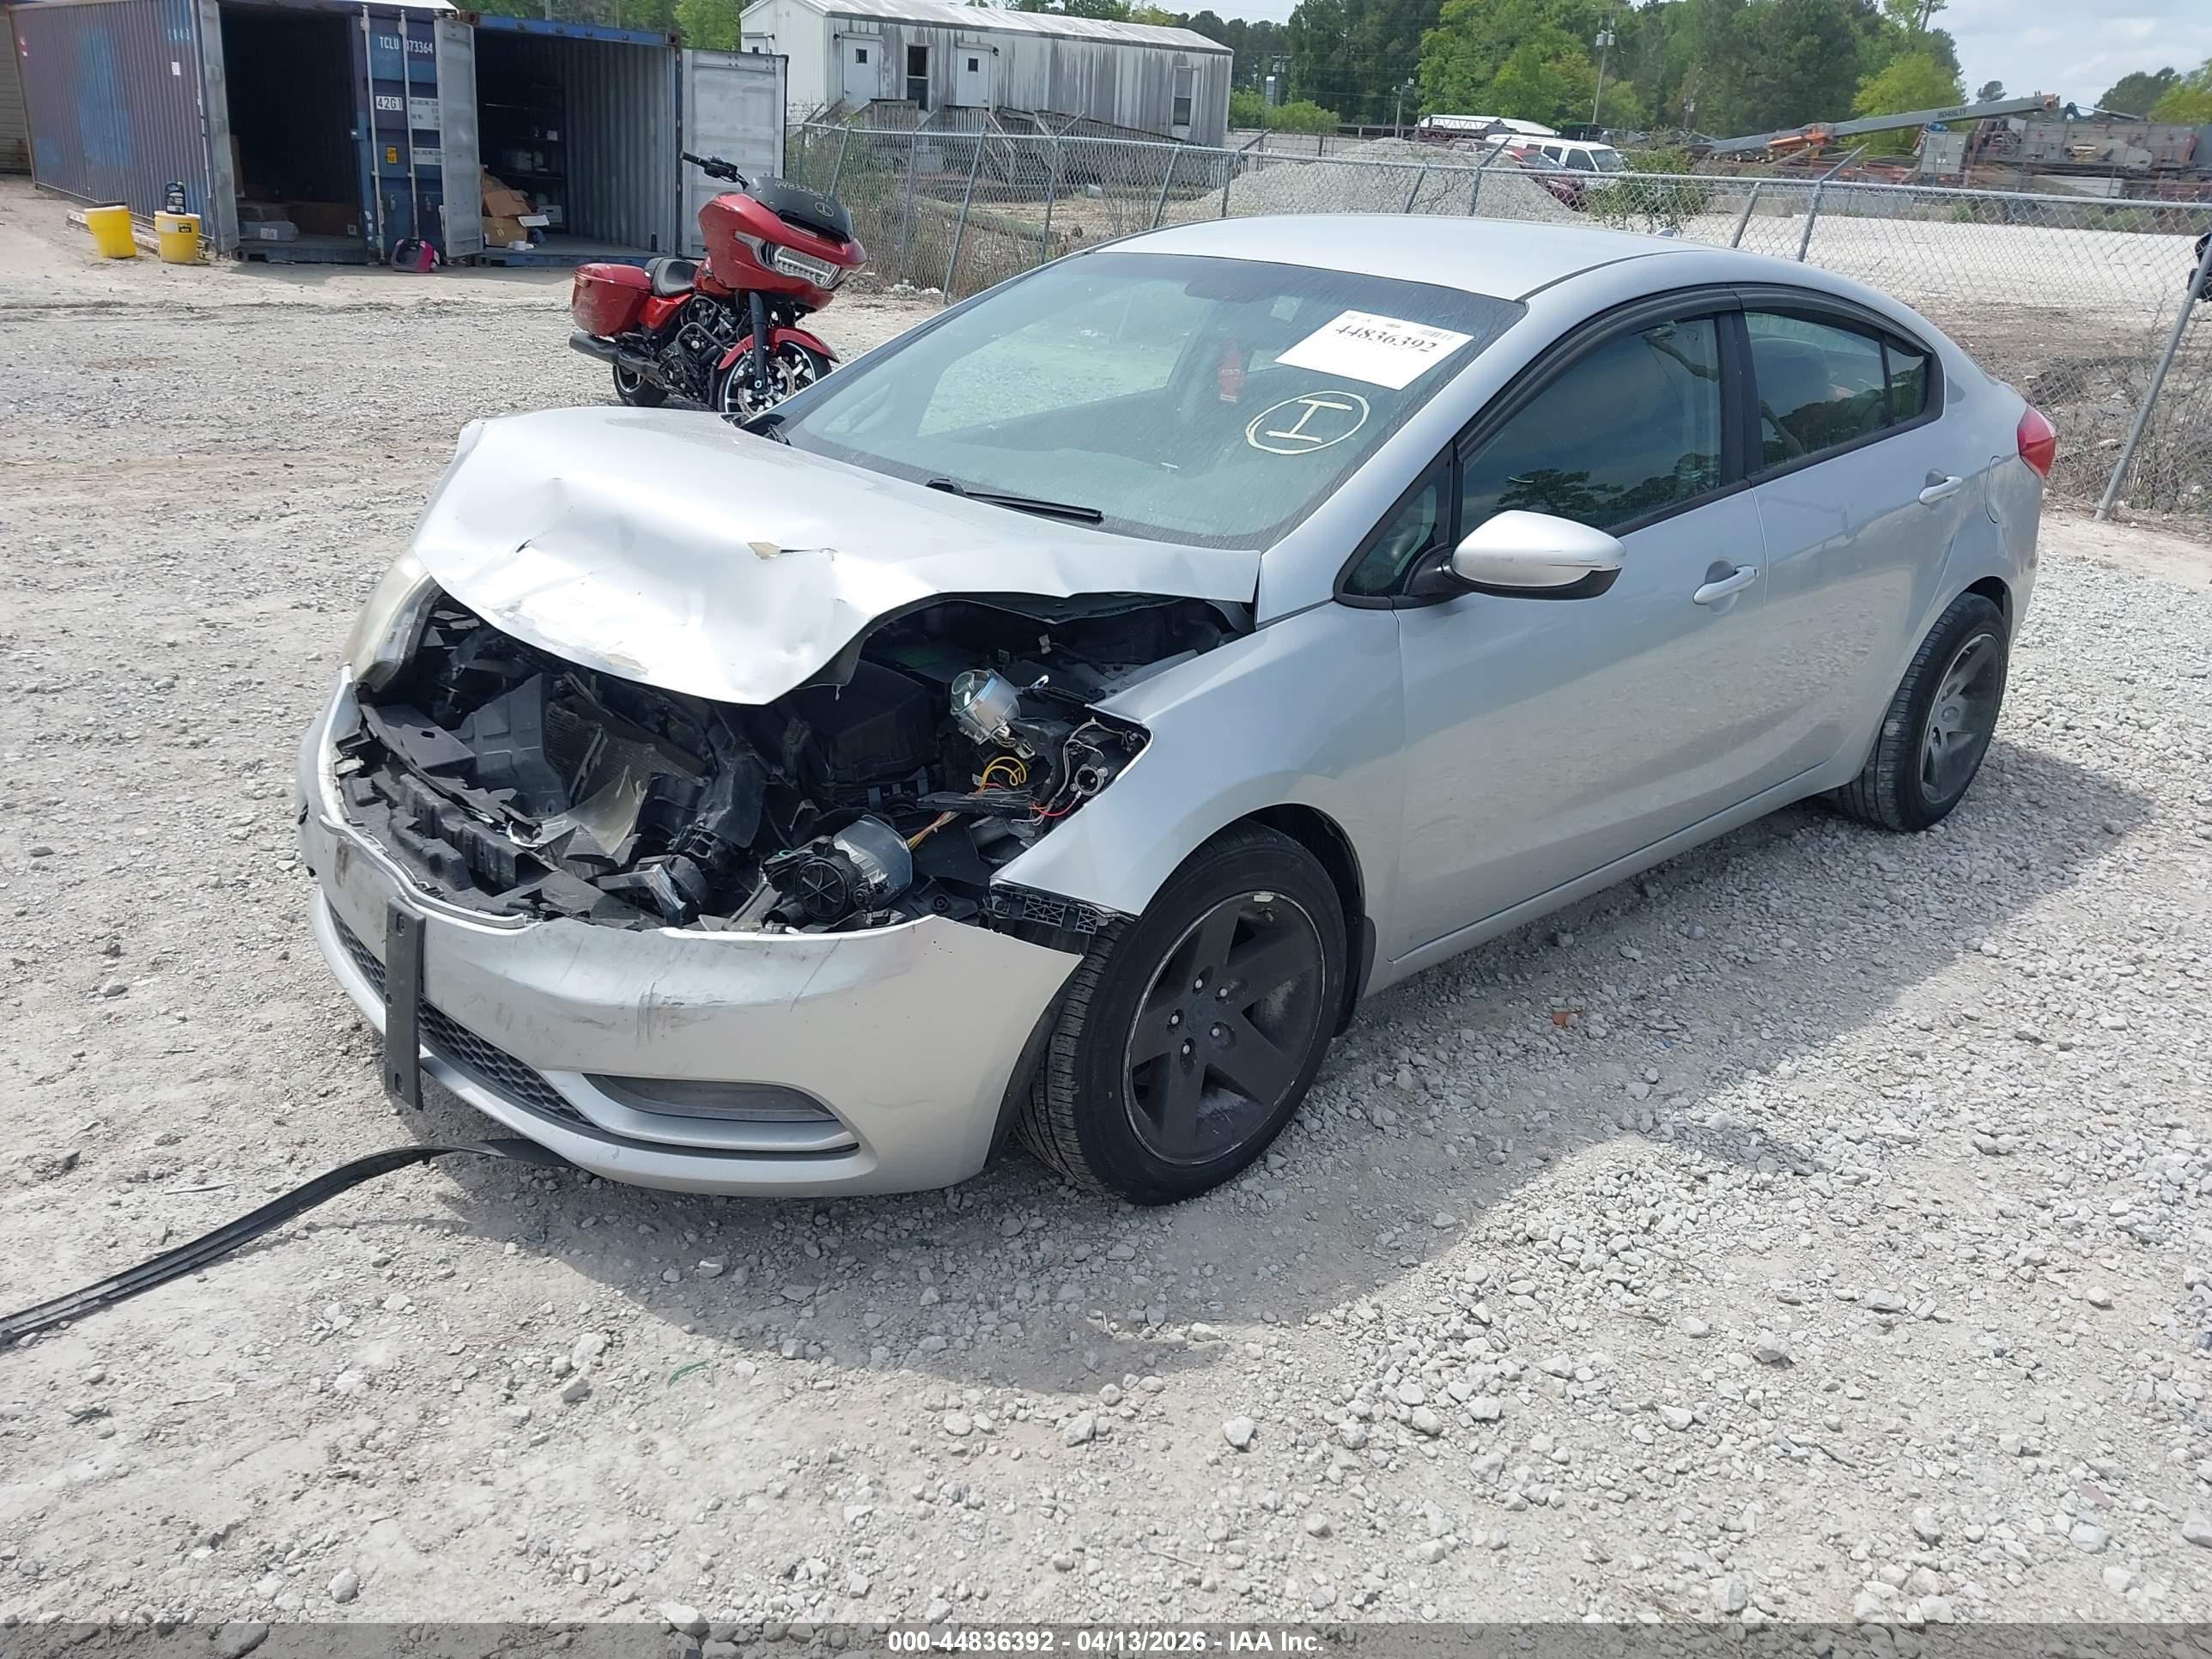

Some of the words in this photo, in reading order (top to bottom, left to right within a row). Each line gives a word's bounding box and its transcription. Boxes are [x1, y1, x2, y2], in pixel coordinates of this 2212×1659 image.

[379, 36, 399, 50] TCLU
[377, 97, 402, 110] 42G1
[1335, 325, 1437, 352] 44836392
